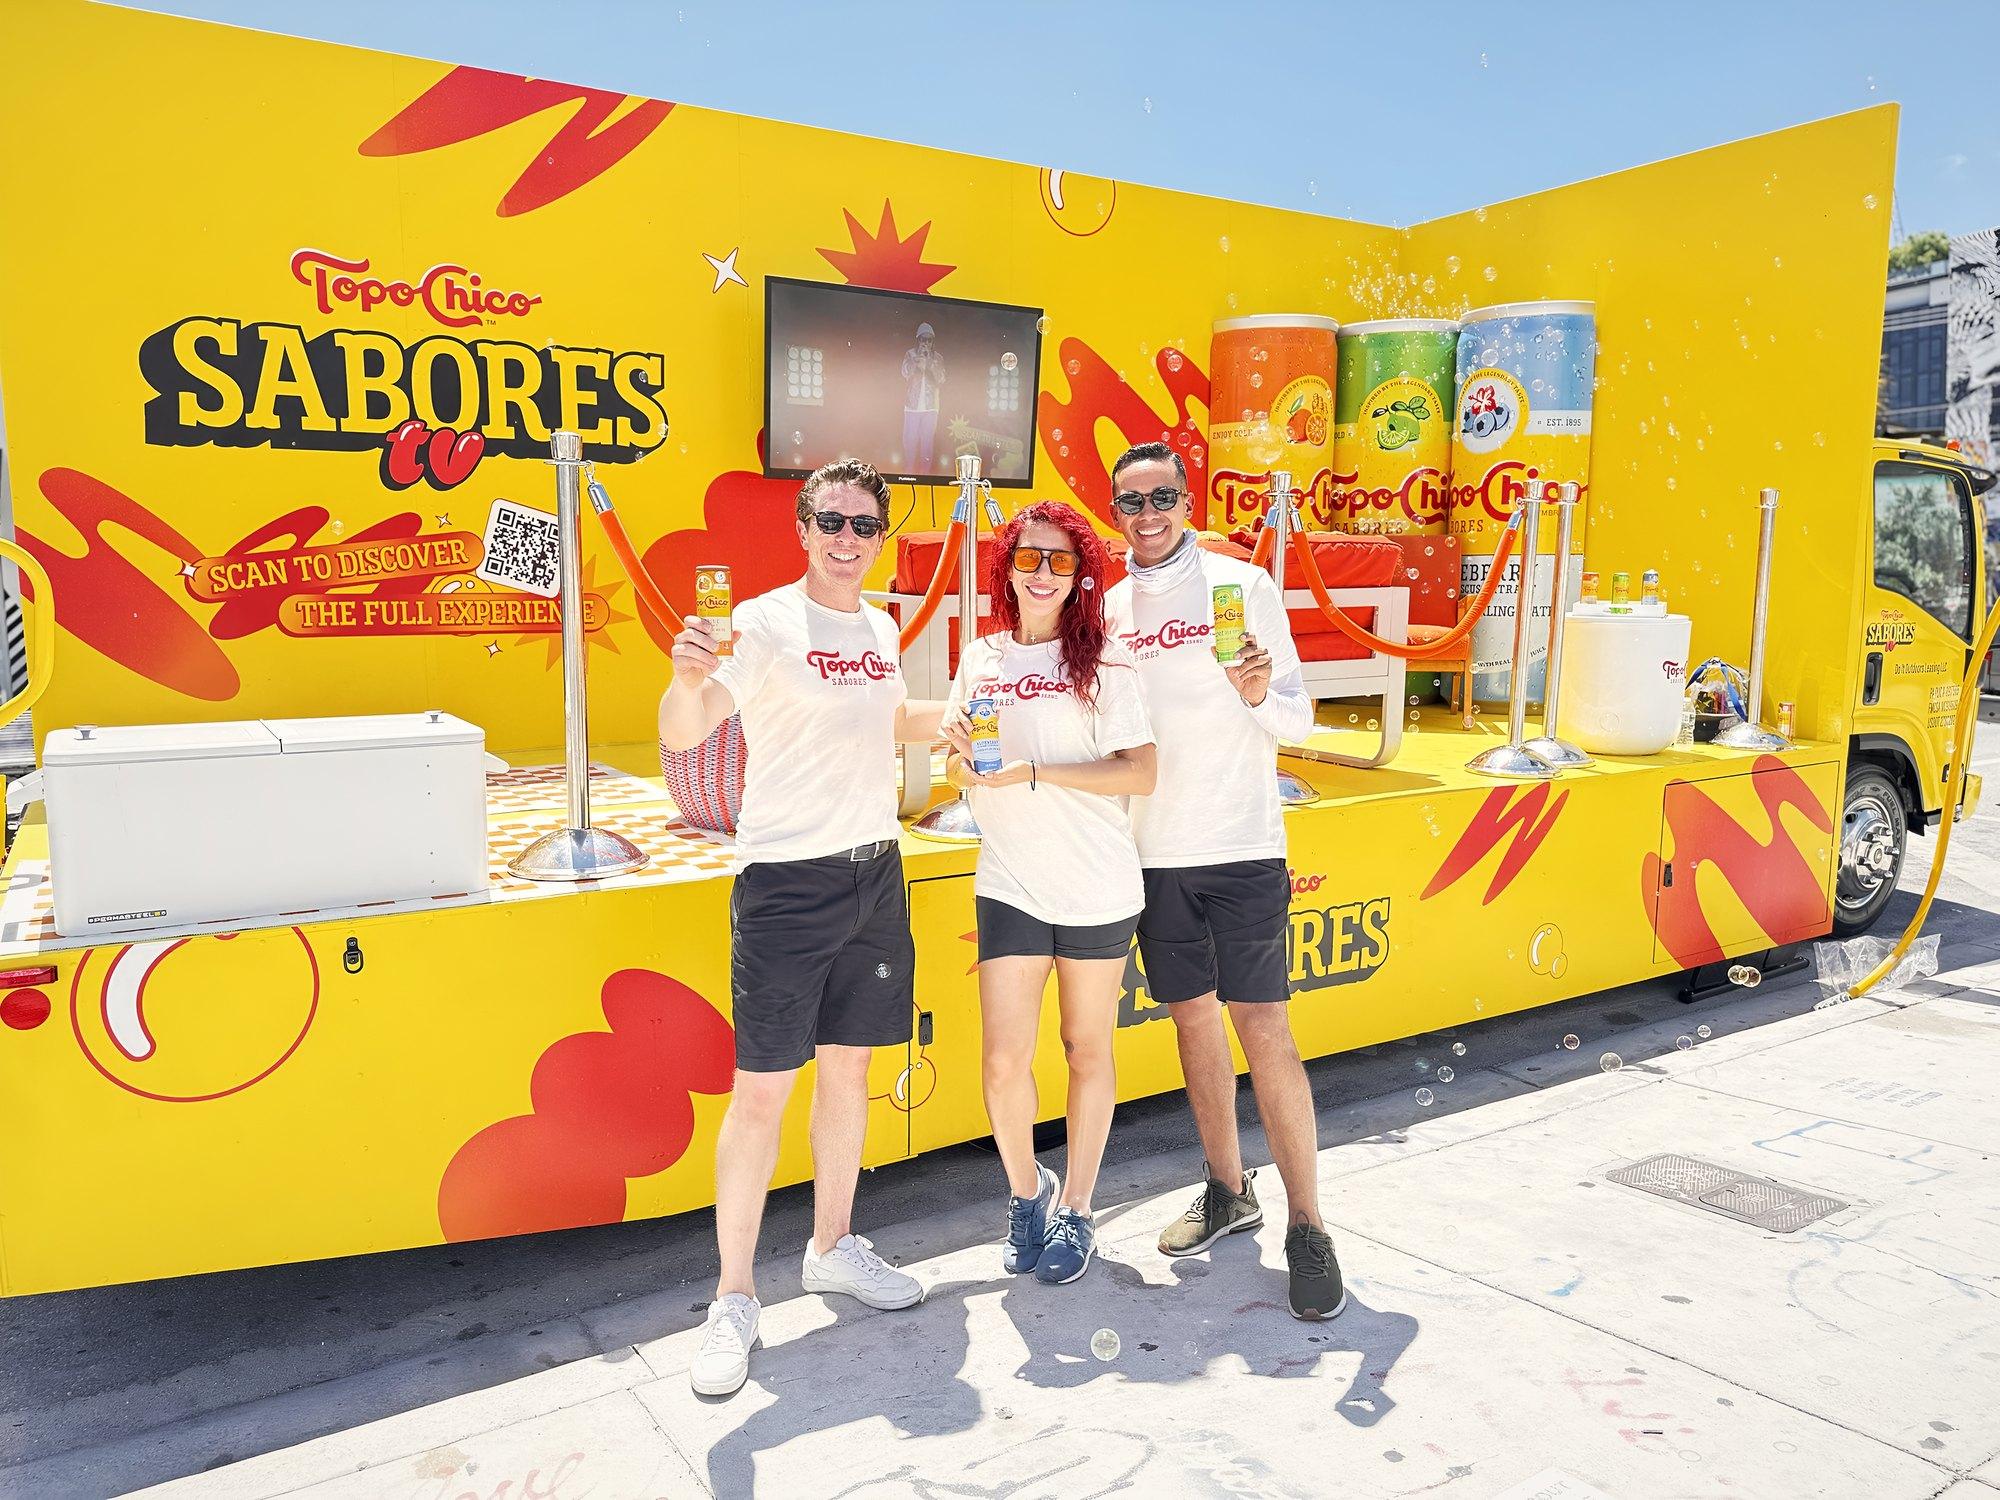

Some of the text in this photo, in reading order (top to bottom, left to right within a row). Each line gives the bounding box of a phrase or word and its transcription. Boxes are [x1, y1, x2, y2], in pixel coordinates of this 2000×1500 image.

[291, 248, 543, 328] Topo Chico
[145, 317, 669, 460] SABORES
[1212, 430, 1233, 439] ENJOY
[1546, 417, 1582, 427] EST. 1895
[382, 420, 486, 491] tv
[1334, 522, 1403, 535] SABORES
[209, 539, 470, 595] SCAN TO DISCOVER
[297, 599, 596, 628] THE FULL EXPERIENE
[704, 595, 728, 609] Chico
[1224, 608, 1244, 620] Chico
[1158, 618, 1215, 650] Chico
[1866, 622, 1916, 645] SABORES
[1530, 646, 1547, 657] JUICE
[806, 650, 862, 679] Topo
[831, 678, 868, 686] SABORES
[1014, 673, 1074, 700] Chico
[1883, 791, 1896, 816] FUEL
[1288, 868, 1327, 894] ico
